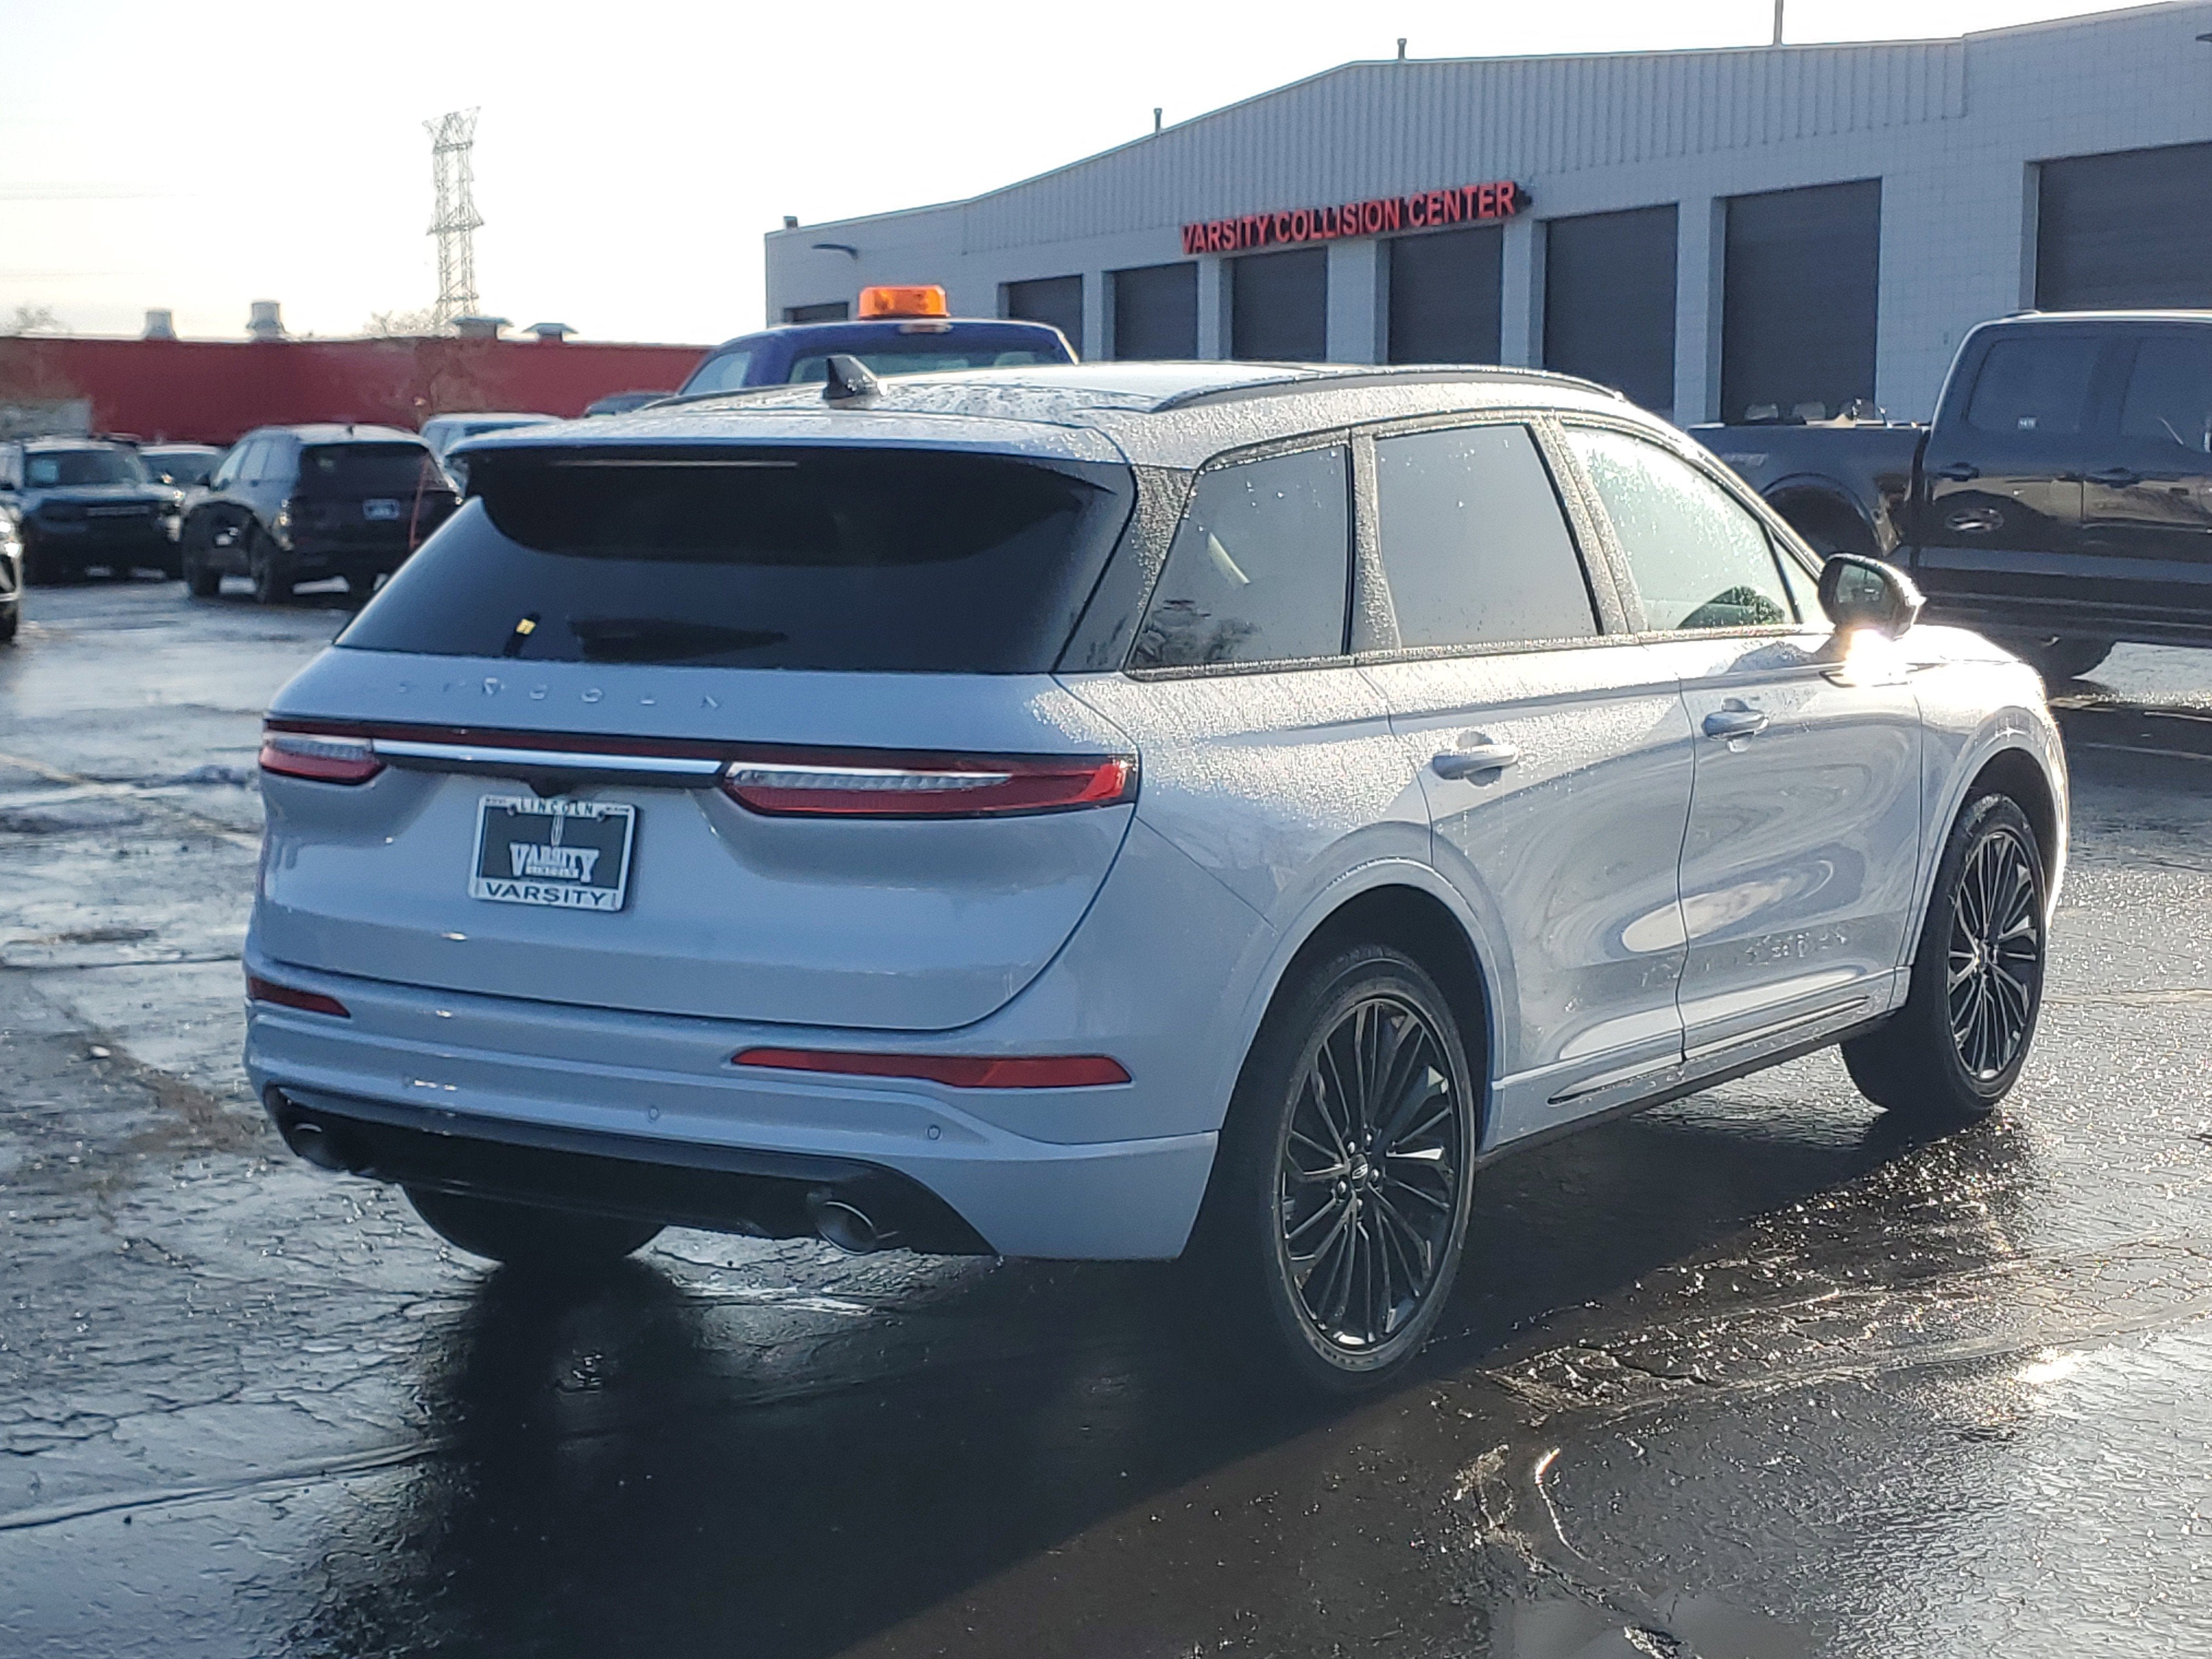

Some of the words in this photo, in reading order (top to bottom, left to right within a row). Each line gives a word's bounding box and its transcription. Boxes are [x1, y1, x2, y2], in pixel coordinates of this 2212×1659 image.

[1181, 213, 1270, 254] VARSITY
[1275, 198, 1400, 242] COLLISION
[1408, 181, 1517, 226] CENTER
[520, 798, 594, 815] LINCOLN
[486, 881, 607, 905] VARSITY
